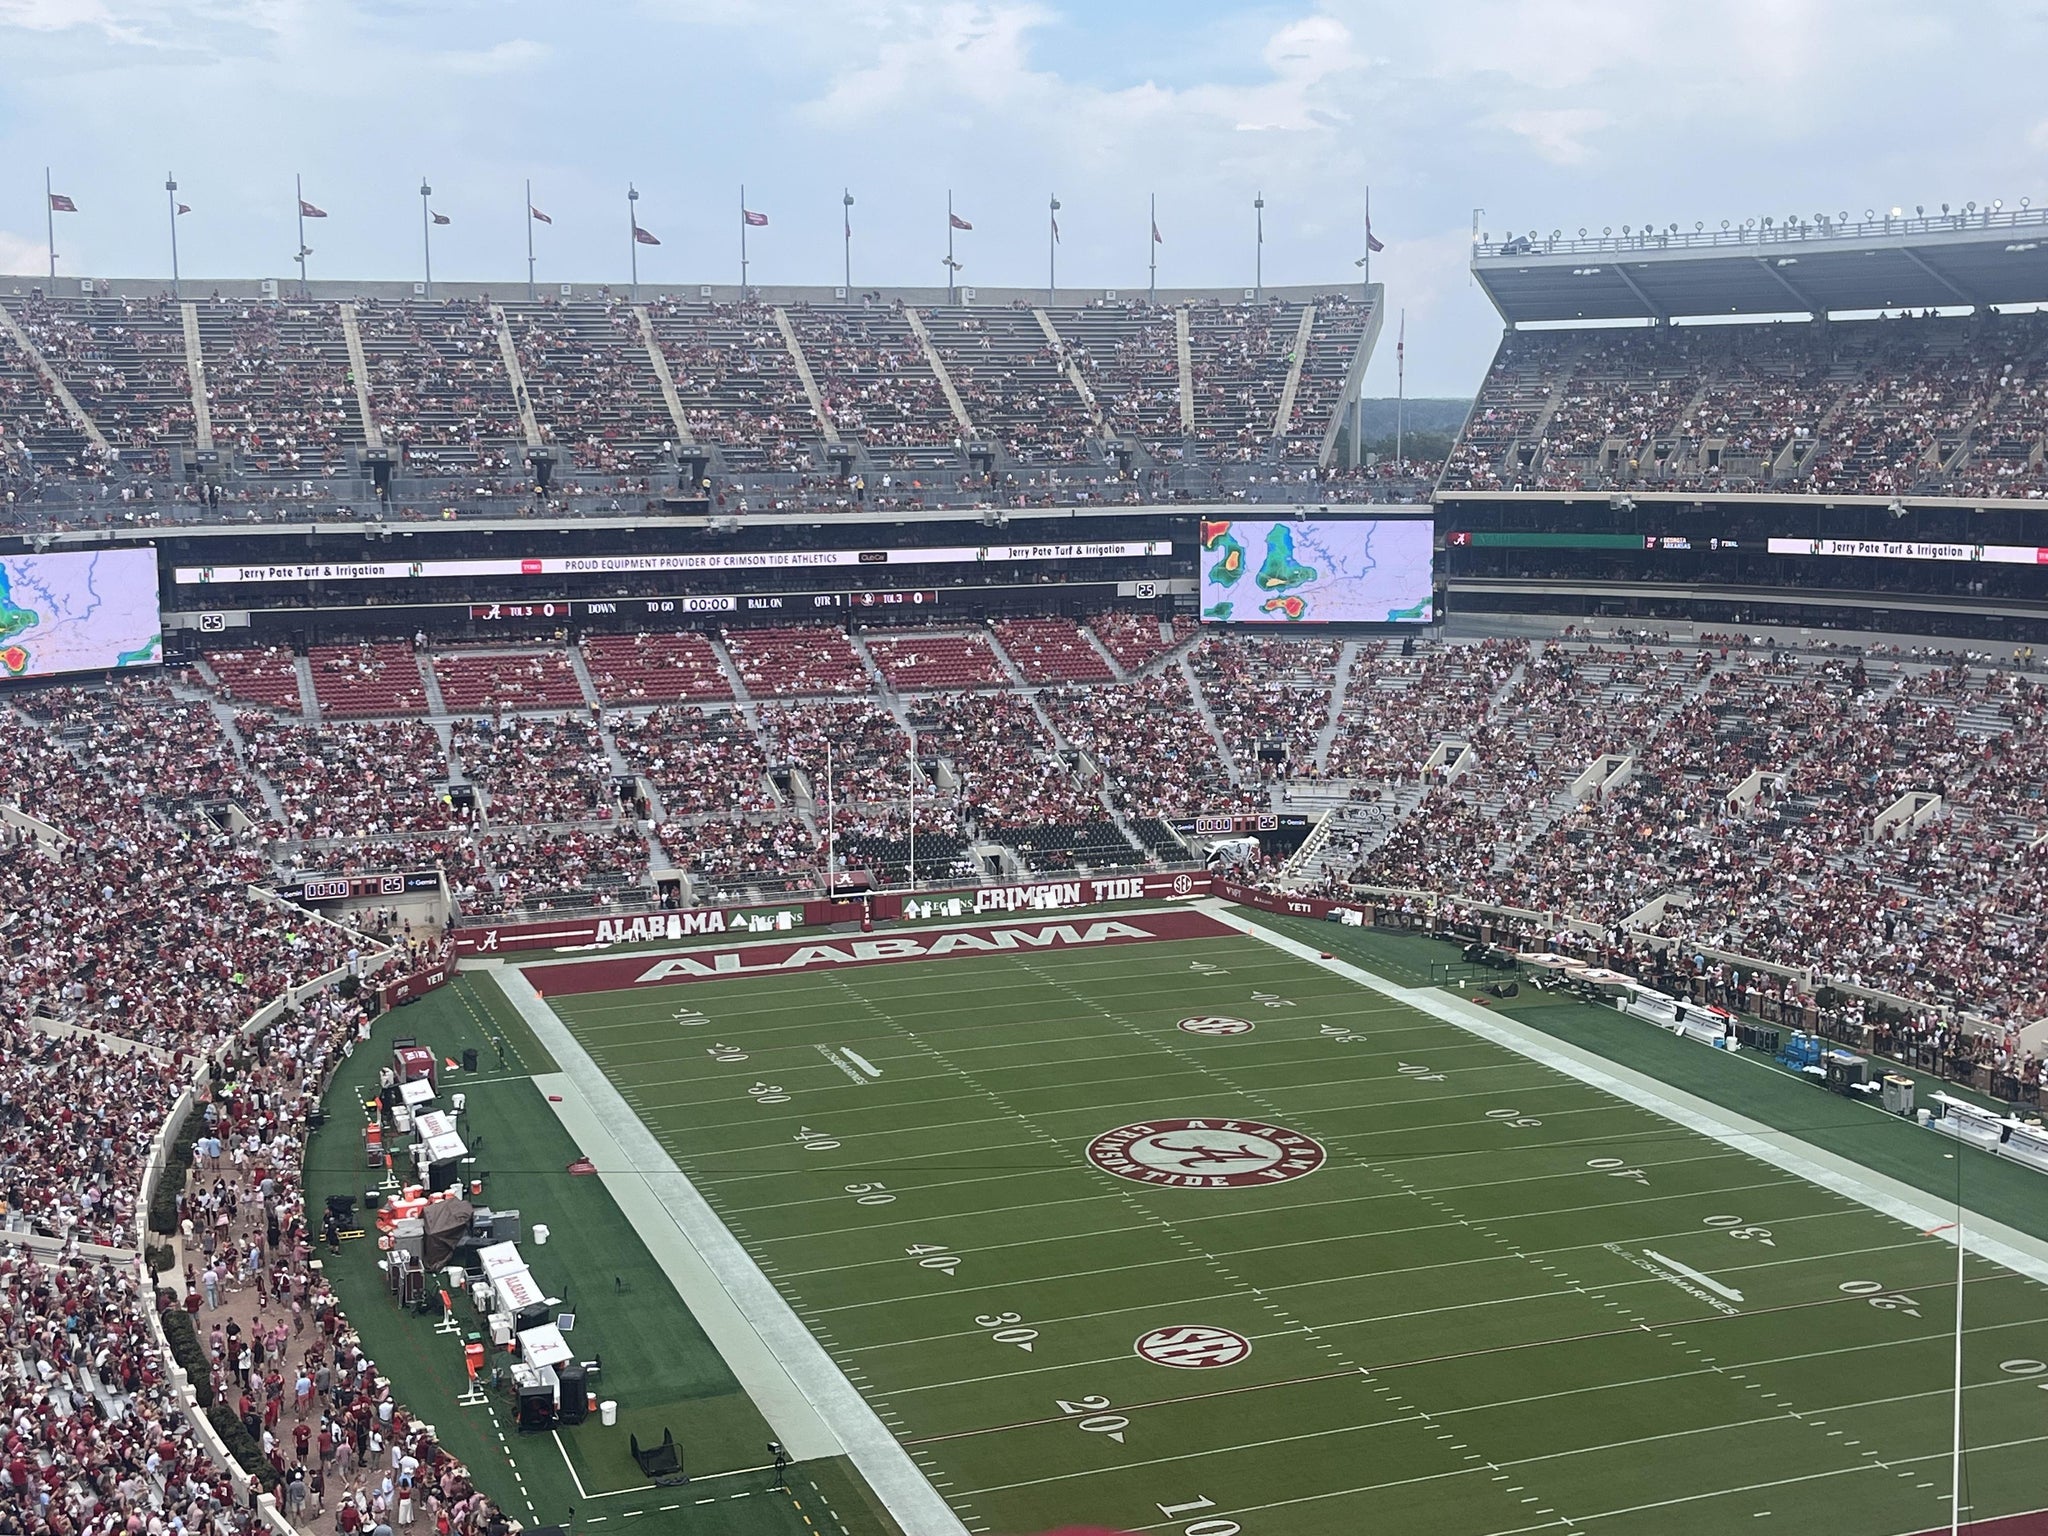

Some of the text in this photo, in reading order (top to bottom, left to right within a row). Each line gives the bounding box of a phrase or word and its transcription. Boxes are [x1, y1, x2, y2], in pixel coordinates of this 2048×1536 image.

[1008, 545, 1125, 559] Jerry Pate Turf & Irrigation
[1832, 541, 1963, 558] Jerry Pate Turf & Irrigation
[566, 554, 837, 570] PROUD EQUIPMENT PROVIDER OF CRIMSON TIDE ATHLETICS
[239, 566, 385, 580] Jerry Pate Turf & Irrigation
[913, 592, 922, 604] 0
[1139, 585, 1153, 596] 25
[647, 602, 674, 612] TO GO
[689, 599, 729, 610] 00:00
[748, 598, 782, 609] BALL ON
[814, 596, 840, 607] QTR 1
[883, 594, 902, 604] TOL 3
[510, 606, 533, 616] TOL 3
[544, 604, 554, 616] 0
[588, 604, 616, 614] DOWN
[204, 616, 222, 629] 25
[1261, 816, 1275, 828] 25
[308, 882, 346, 897] 00:00
[384, 878, 400, 891] 25
[1175, 876, 1191, 893] SEC
[284, 890, 302, 898] Gemini
[976, 878, 1144, 910] CRIMSON TIDE
[924, 900, 973, 911] REGNS
[1288, 902, 1311, 912] YETI
[751, 912, 803, 924] RGINS
[634, 920, 1157, 983] ALABAMA
[1189, 963, 1232, 977] 10
[427, 972, 444, 986] YETI
[1250, 994, 1297, 1008] 20
[672, 1010, 710, 1026] 10
[1180, 1017, 1249, 1035] SEC
[1320, 1028, 1368, 1043] 30
[706, 1046, 749, 1062] 20
[1397, 1065, 1448, 1082] 40
[748, 1085, 792, 1104] 30
[1484, 1108, 1542, 1128] 50
[793, 1132, 841, 1150] 40
[1096, 1125, 1156, 1174] CRIMSON
[1186, 1120, 1316, 1179] ALABAMA
[1586, 1158, 1648, 1178] 40
[1142, 1171, 1230, 1187] TIDE
[844, 1182, 897, 1206] 50
[1702, 1215, 1772, 1240] 30
[905, 1244, 962, 1268] 40
[1602, 1242, 1741, 1315] BUILDSUBMARINES
[1838, 1280, 1920, 1310] 20
[974, 1312, 1039, 1343] 30
[1143, 1328, 1243, 1366] SEC
[1055, 1395, 1130, 1432] 20
[1156, 1494, 1241, 1536] 10
